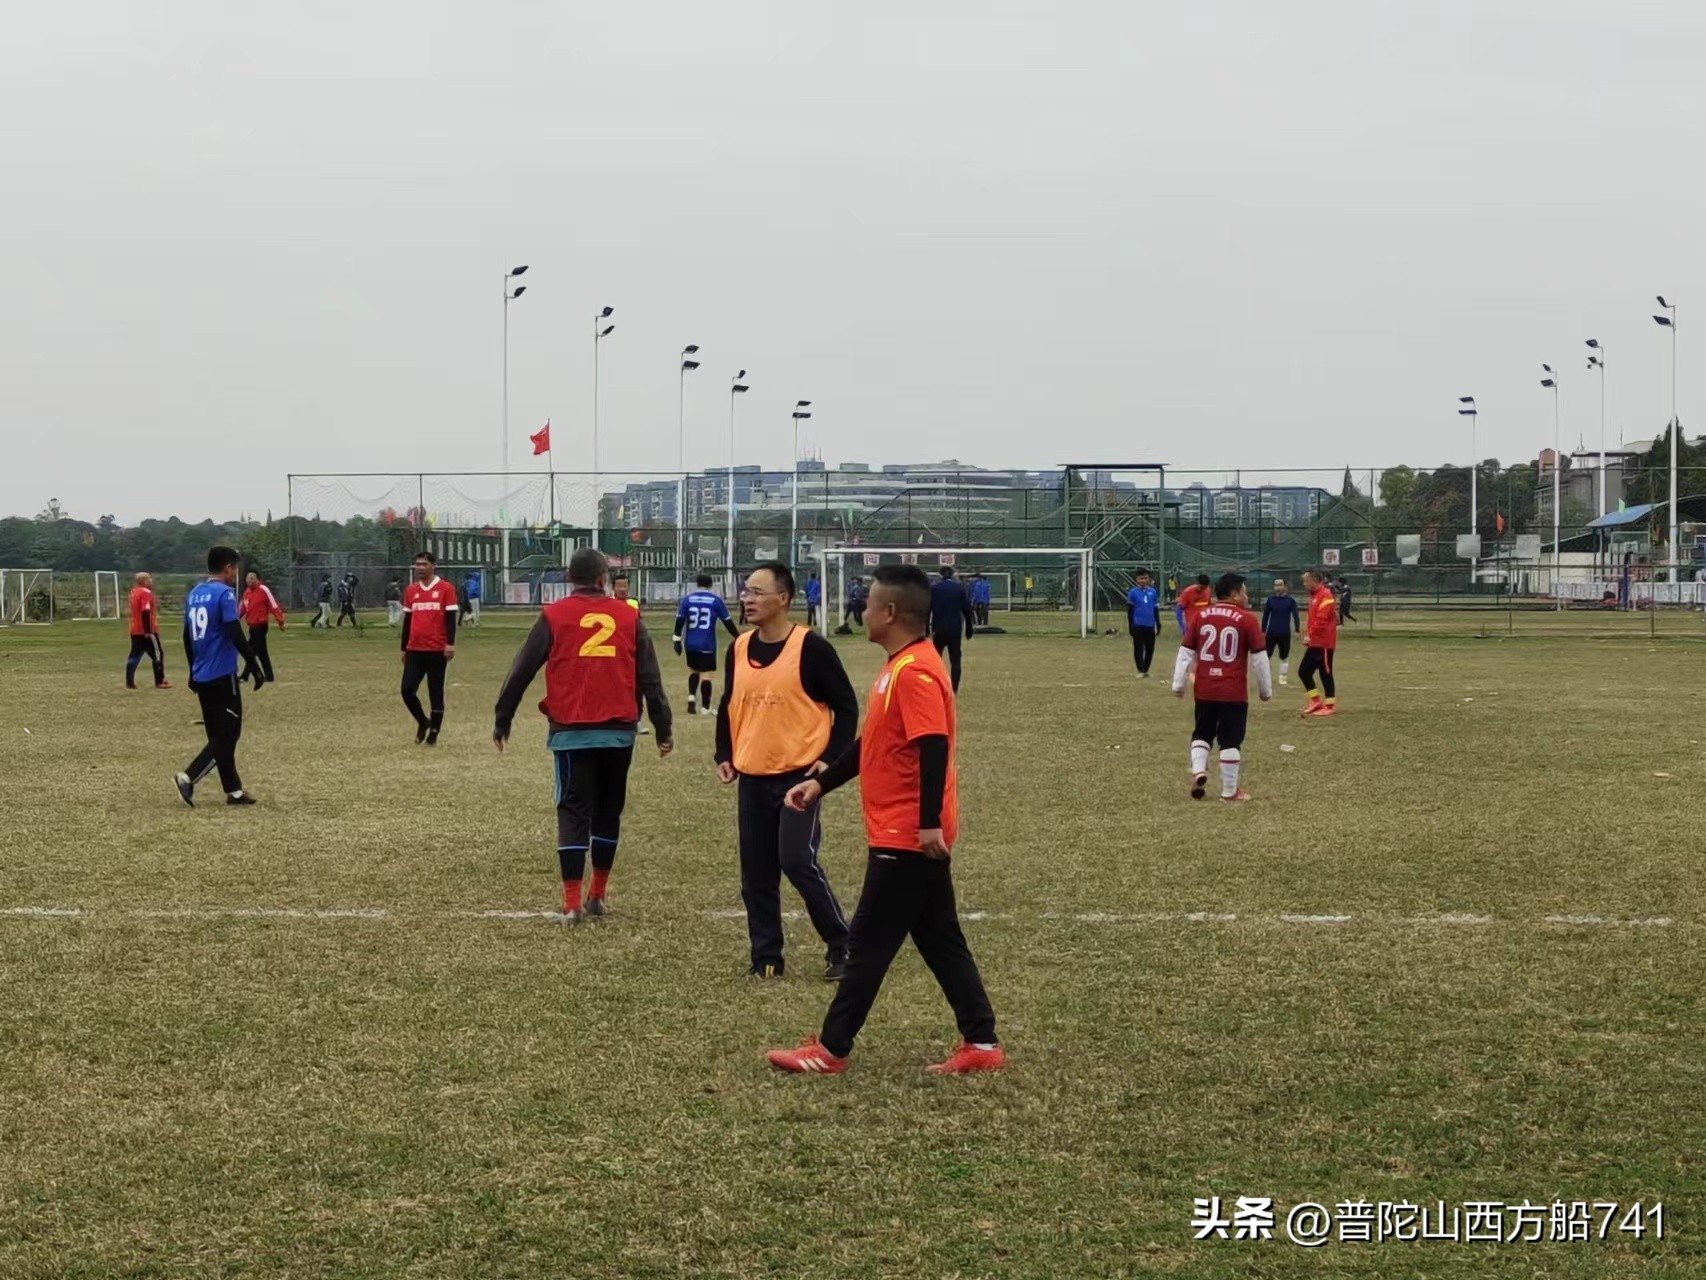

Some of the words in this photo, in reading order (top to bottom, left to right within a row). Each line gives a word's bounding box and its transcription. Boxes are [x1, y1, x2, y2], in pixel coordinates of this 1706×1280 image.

[189, 606, 208, 641] 19
[579, 612, 616, 657] 2
[688, 606, 711, 630] 33
[1200, 624, 1239, 663] 20
